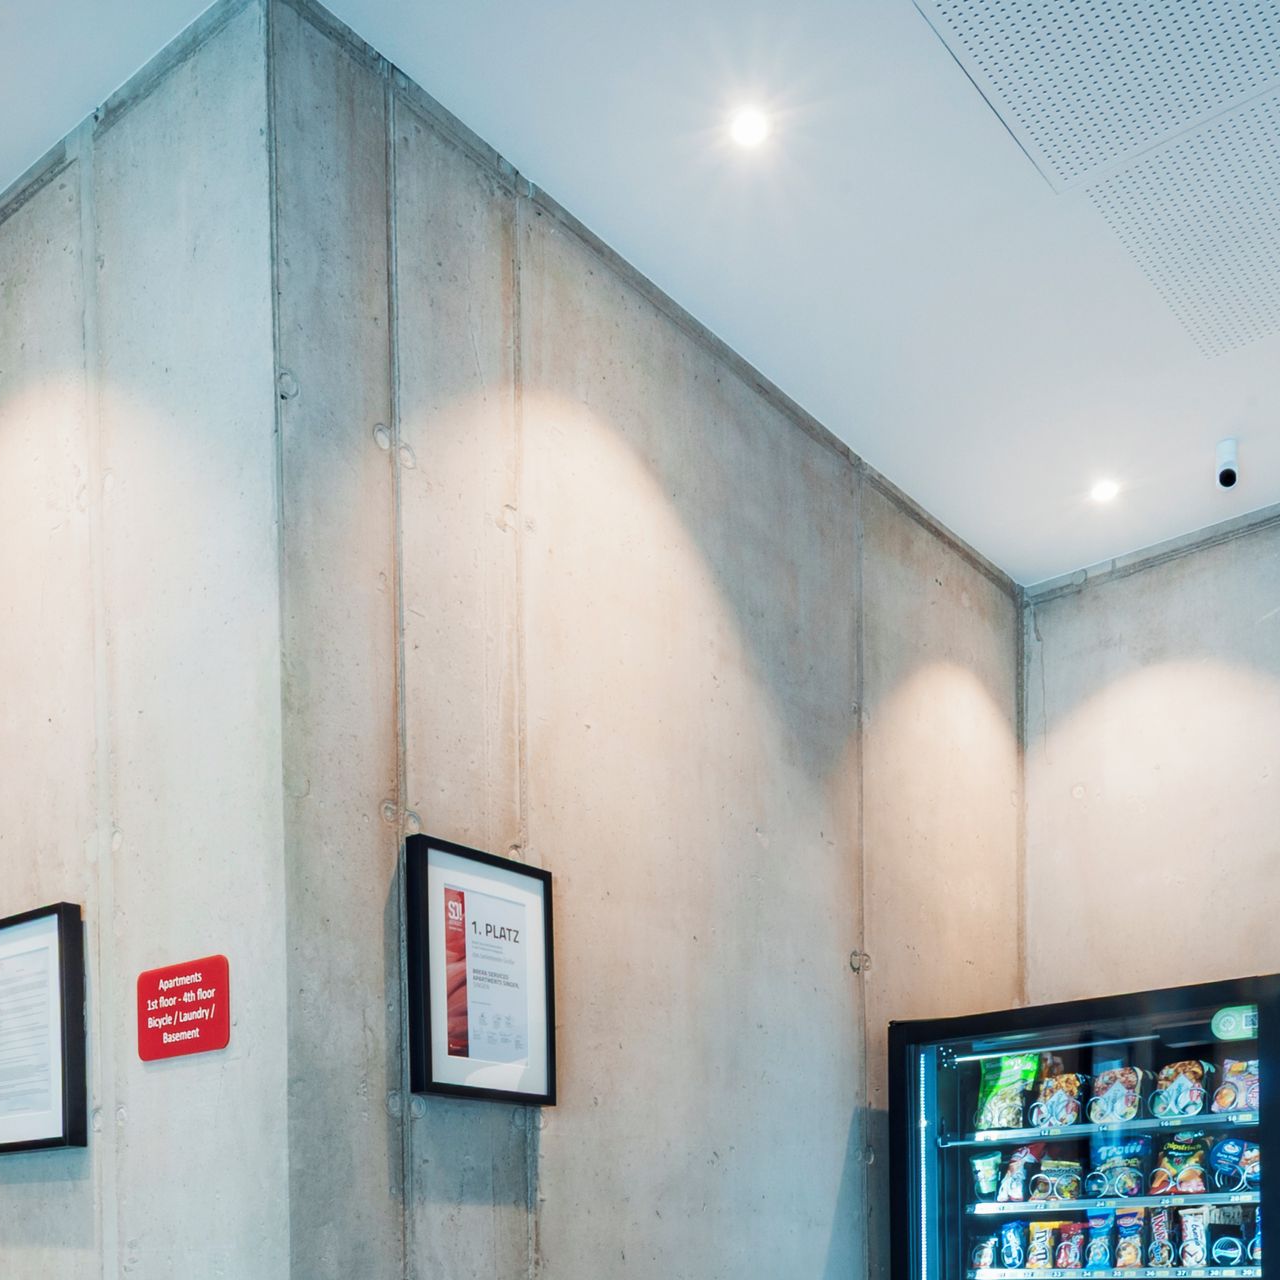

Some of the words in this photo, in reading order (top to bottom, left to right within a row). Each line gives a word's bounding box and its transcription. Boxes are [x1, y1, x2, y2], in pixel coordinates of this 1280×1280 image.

[472, 921, 482, 936] 1.
[485, 923, 520, 944] PLATZ
[158, 972, 202, 992] Apartments
[147, 999, 158, 1011] 1st
[159, 996, 177, 1009] floor
[182, 990, 196, 1003] 4th
[197, 988, 216, 1001] floor
[147, 1013, 173, 1029] Bicycle
[179, 1006, 210, 1023] Laundry
[163, 1027, 200, 1044] Basement
